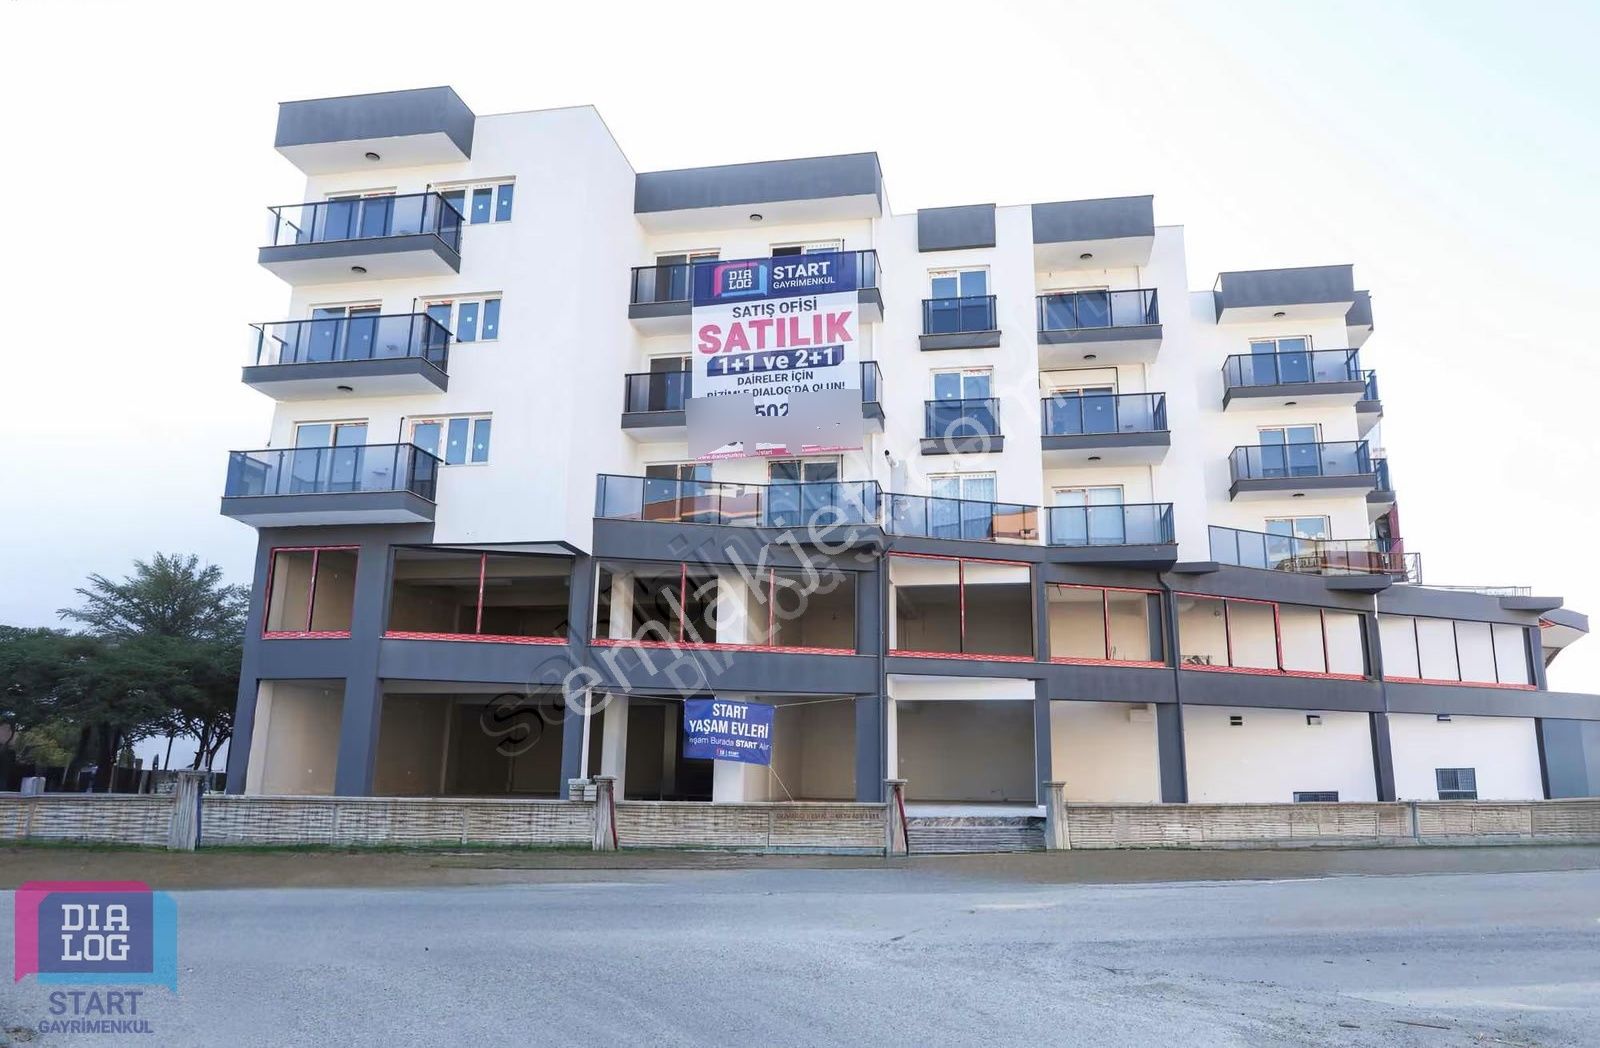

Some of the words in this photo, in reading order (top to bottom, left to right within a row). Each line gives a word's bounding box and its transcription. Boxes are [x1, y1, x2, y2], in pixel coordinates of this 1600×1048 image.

[729, 269, 752, 281] DIA
[772, 262, 831, 280] START
[729, 279, 752, 290] LOG
[772, 277, 836, 290] GAYRİMENKUL
[732, 303, 775, 319] SATIŞ
[779, 296, 817, 314] OFİSİ
[698, 311, 853, 355] SATILIK
[719, 355, 754, 374] 1+1
[762, 356, 789, 370] ve
[795, 347, 833, 368] 2+1
[737, 372, 788, 386] DAİRELER
[791, 370, 814, 383] İÇİN
[712, 703, 749, 720] START
[688, 719, 729, 735] YAŞAM
[731, 721, 769, 739] EVLERİ
[710, 736, 735, 747] Burada
[735, 739, 757, 749] START
